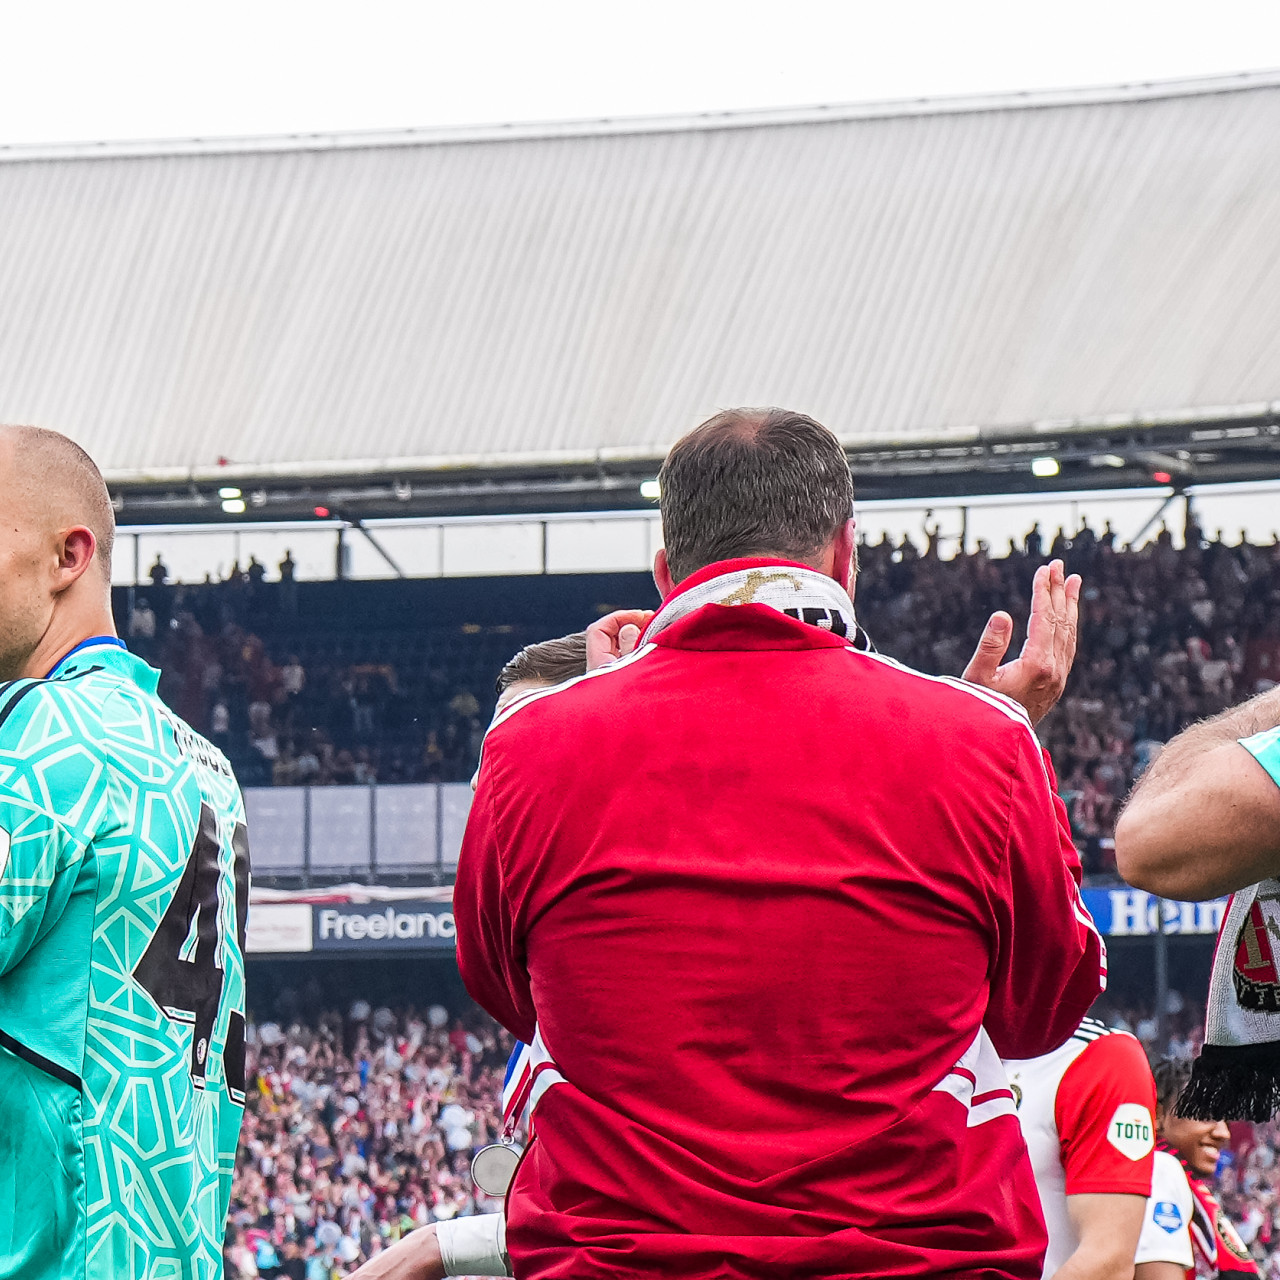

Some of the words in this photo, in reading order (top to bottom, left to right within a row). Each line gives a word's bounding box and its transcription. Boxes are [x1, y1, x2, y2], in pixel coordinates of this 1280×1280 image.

[319, 907, 457, 941] Freelanc
[1108, 889, 1227, 936] Hein
[130, 798, 251, 1108] 4
[1115, 1121, 1149, 1142] TOTO
